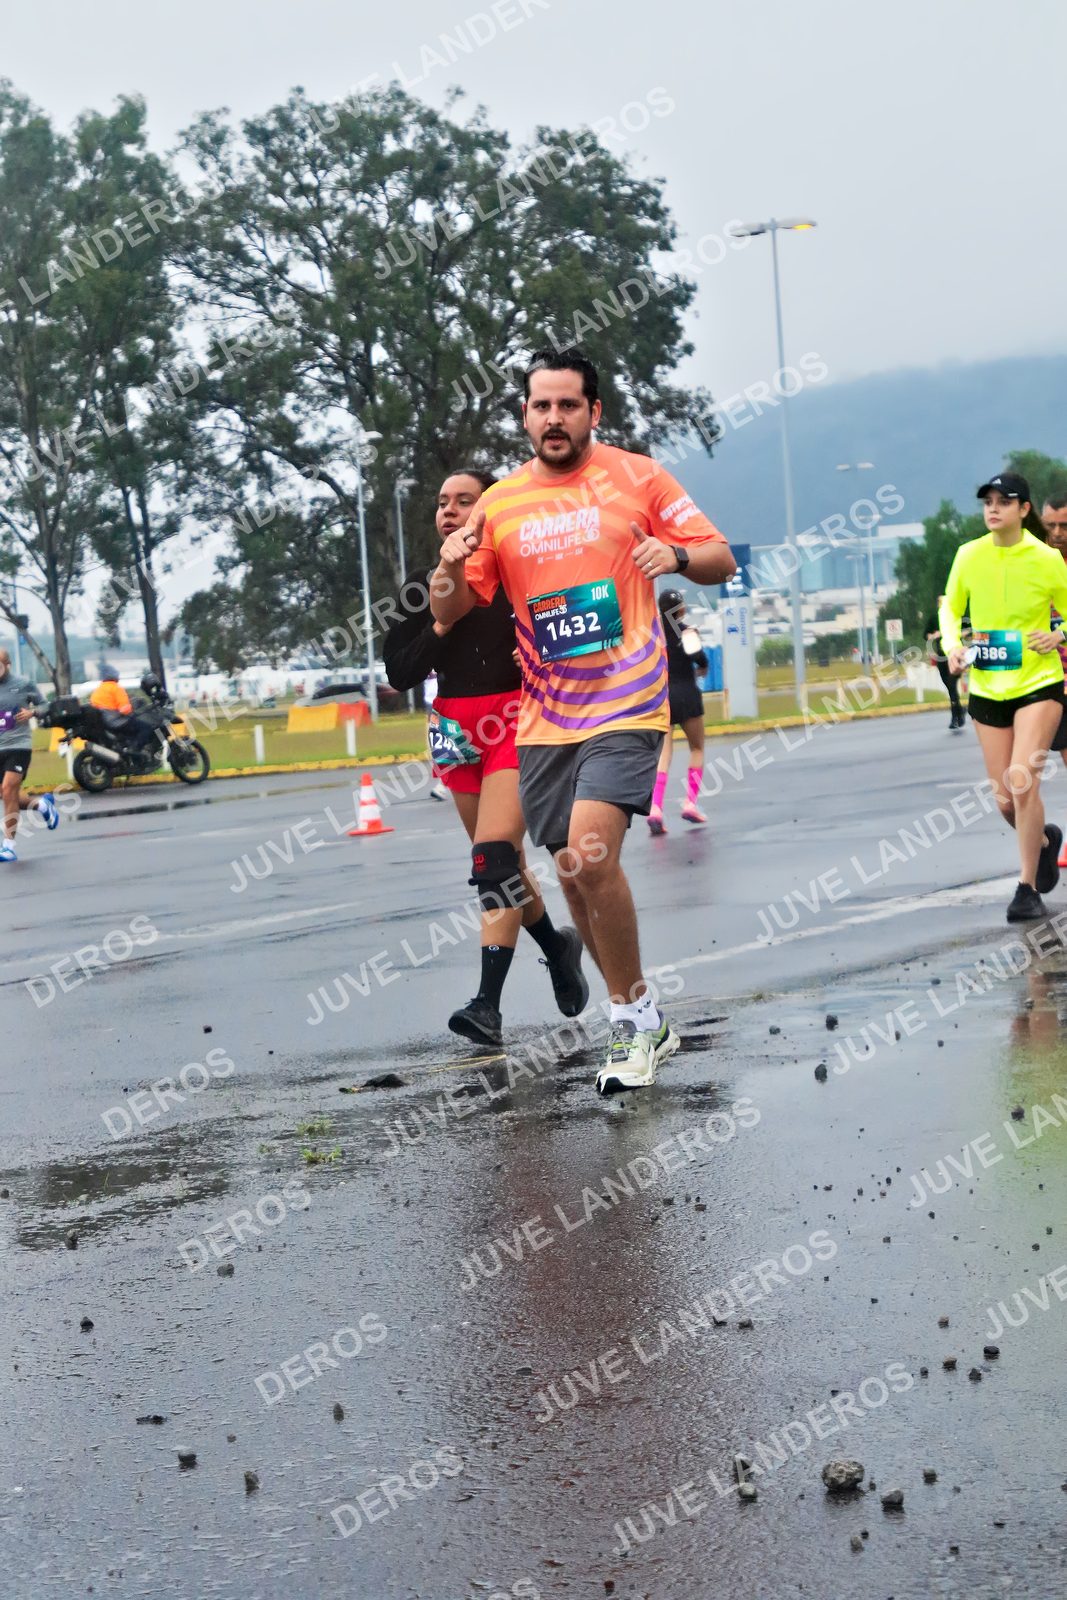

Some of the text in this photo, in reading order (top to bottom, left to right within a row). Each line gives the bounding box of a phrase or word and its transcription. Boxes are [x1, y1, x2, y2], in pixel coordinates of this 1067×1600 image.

[520, 506, 599, 542] CARRERA
[520, 532, 582, 558] OMNILIFE
[533, 595, 567, 613] CARRERA
[591, 584, 609, 600] 10K
[546, 612, 601, 641] 1432
